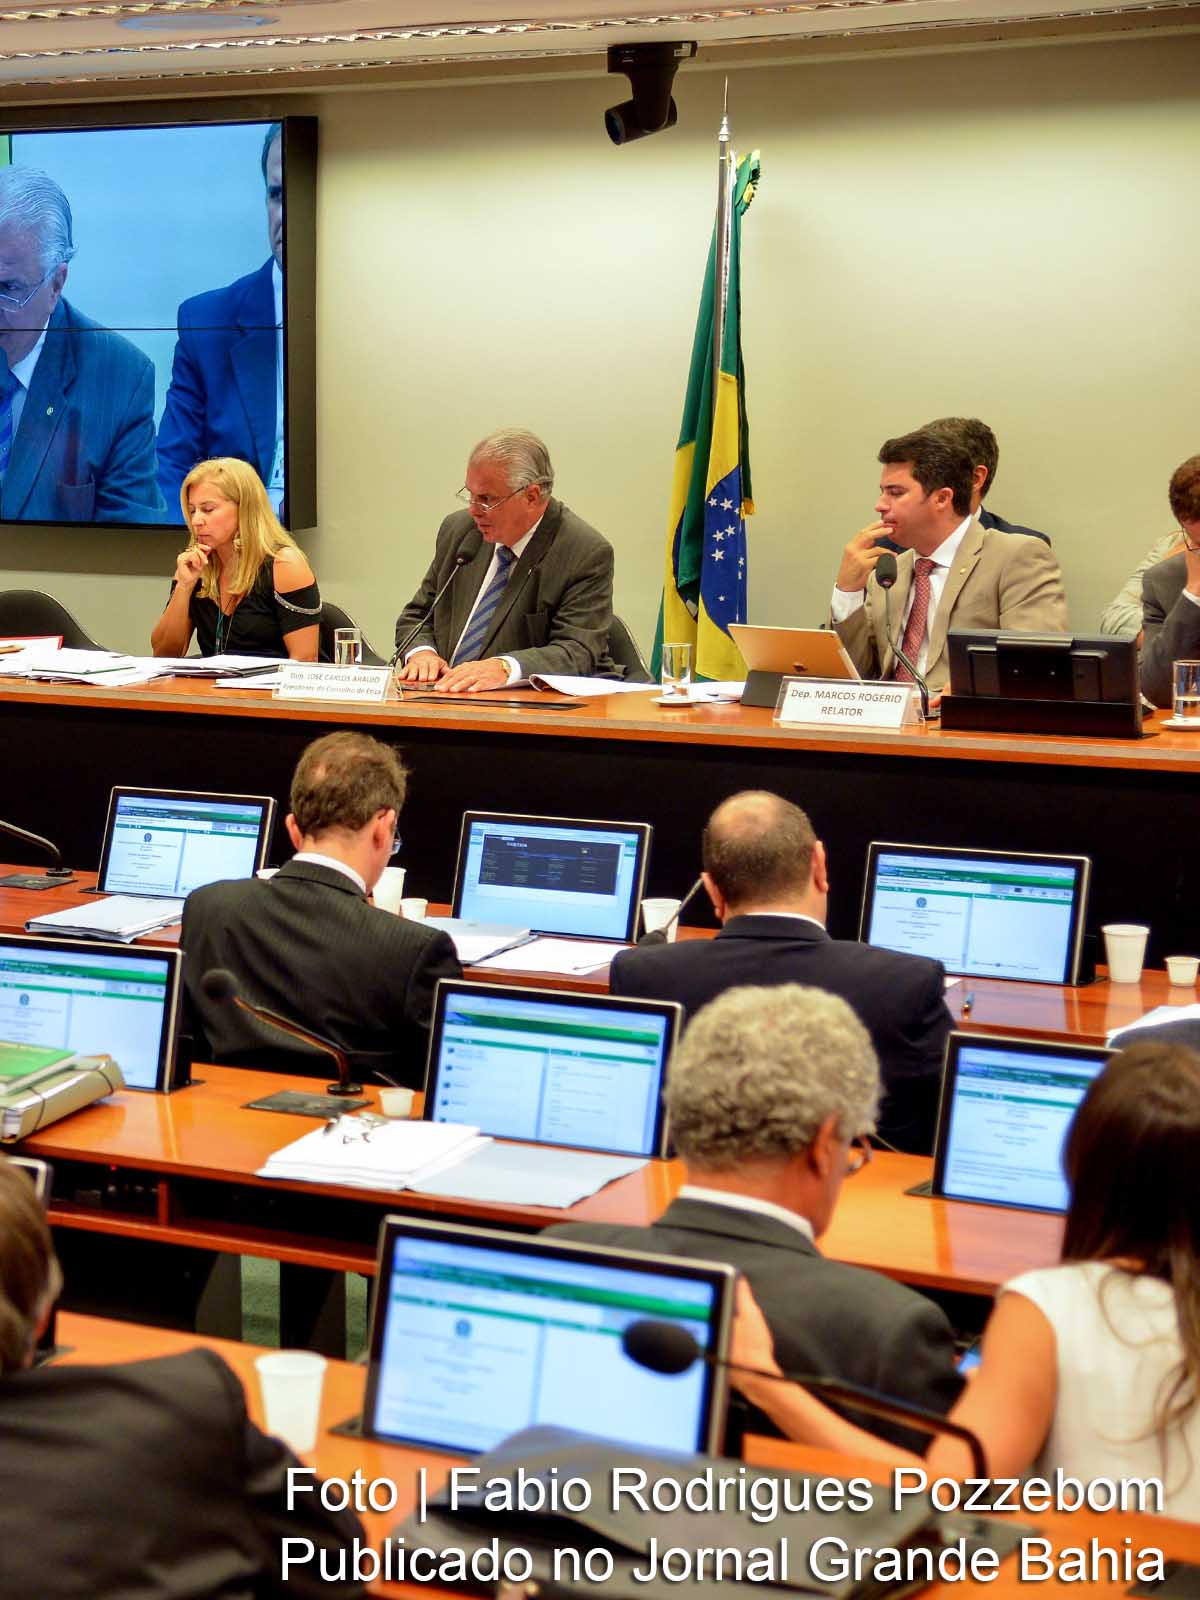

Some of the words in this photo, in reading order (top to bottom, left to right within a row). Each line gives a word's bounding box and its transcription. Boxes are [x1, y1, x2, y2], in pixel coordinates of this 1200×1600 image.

[791, 689, 811, 699] Dep.
[814, 690, 856, 701] MARCOS
[821, 706, 863, 717] RELATOR
